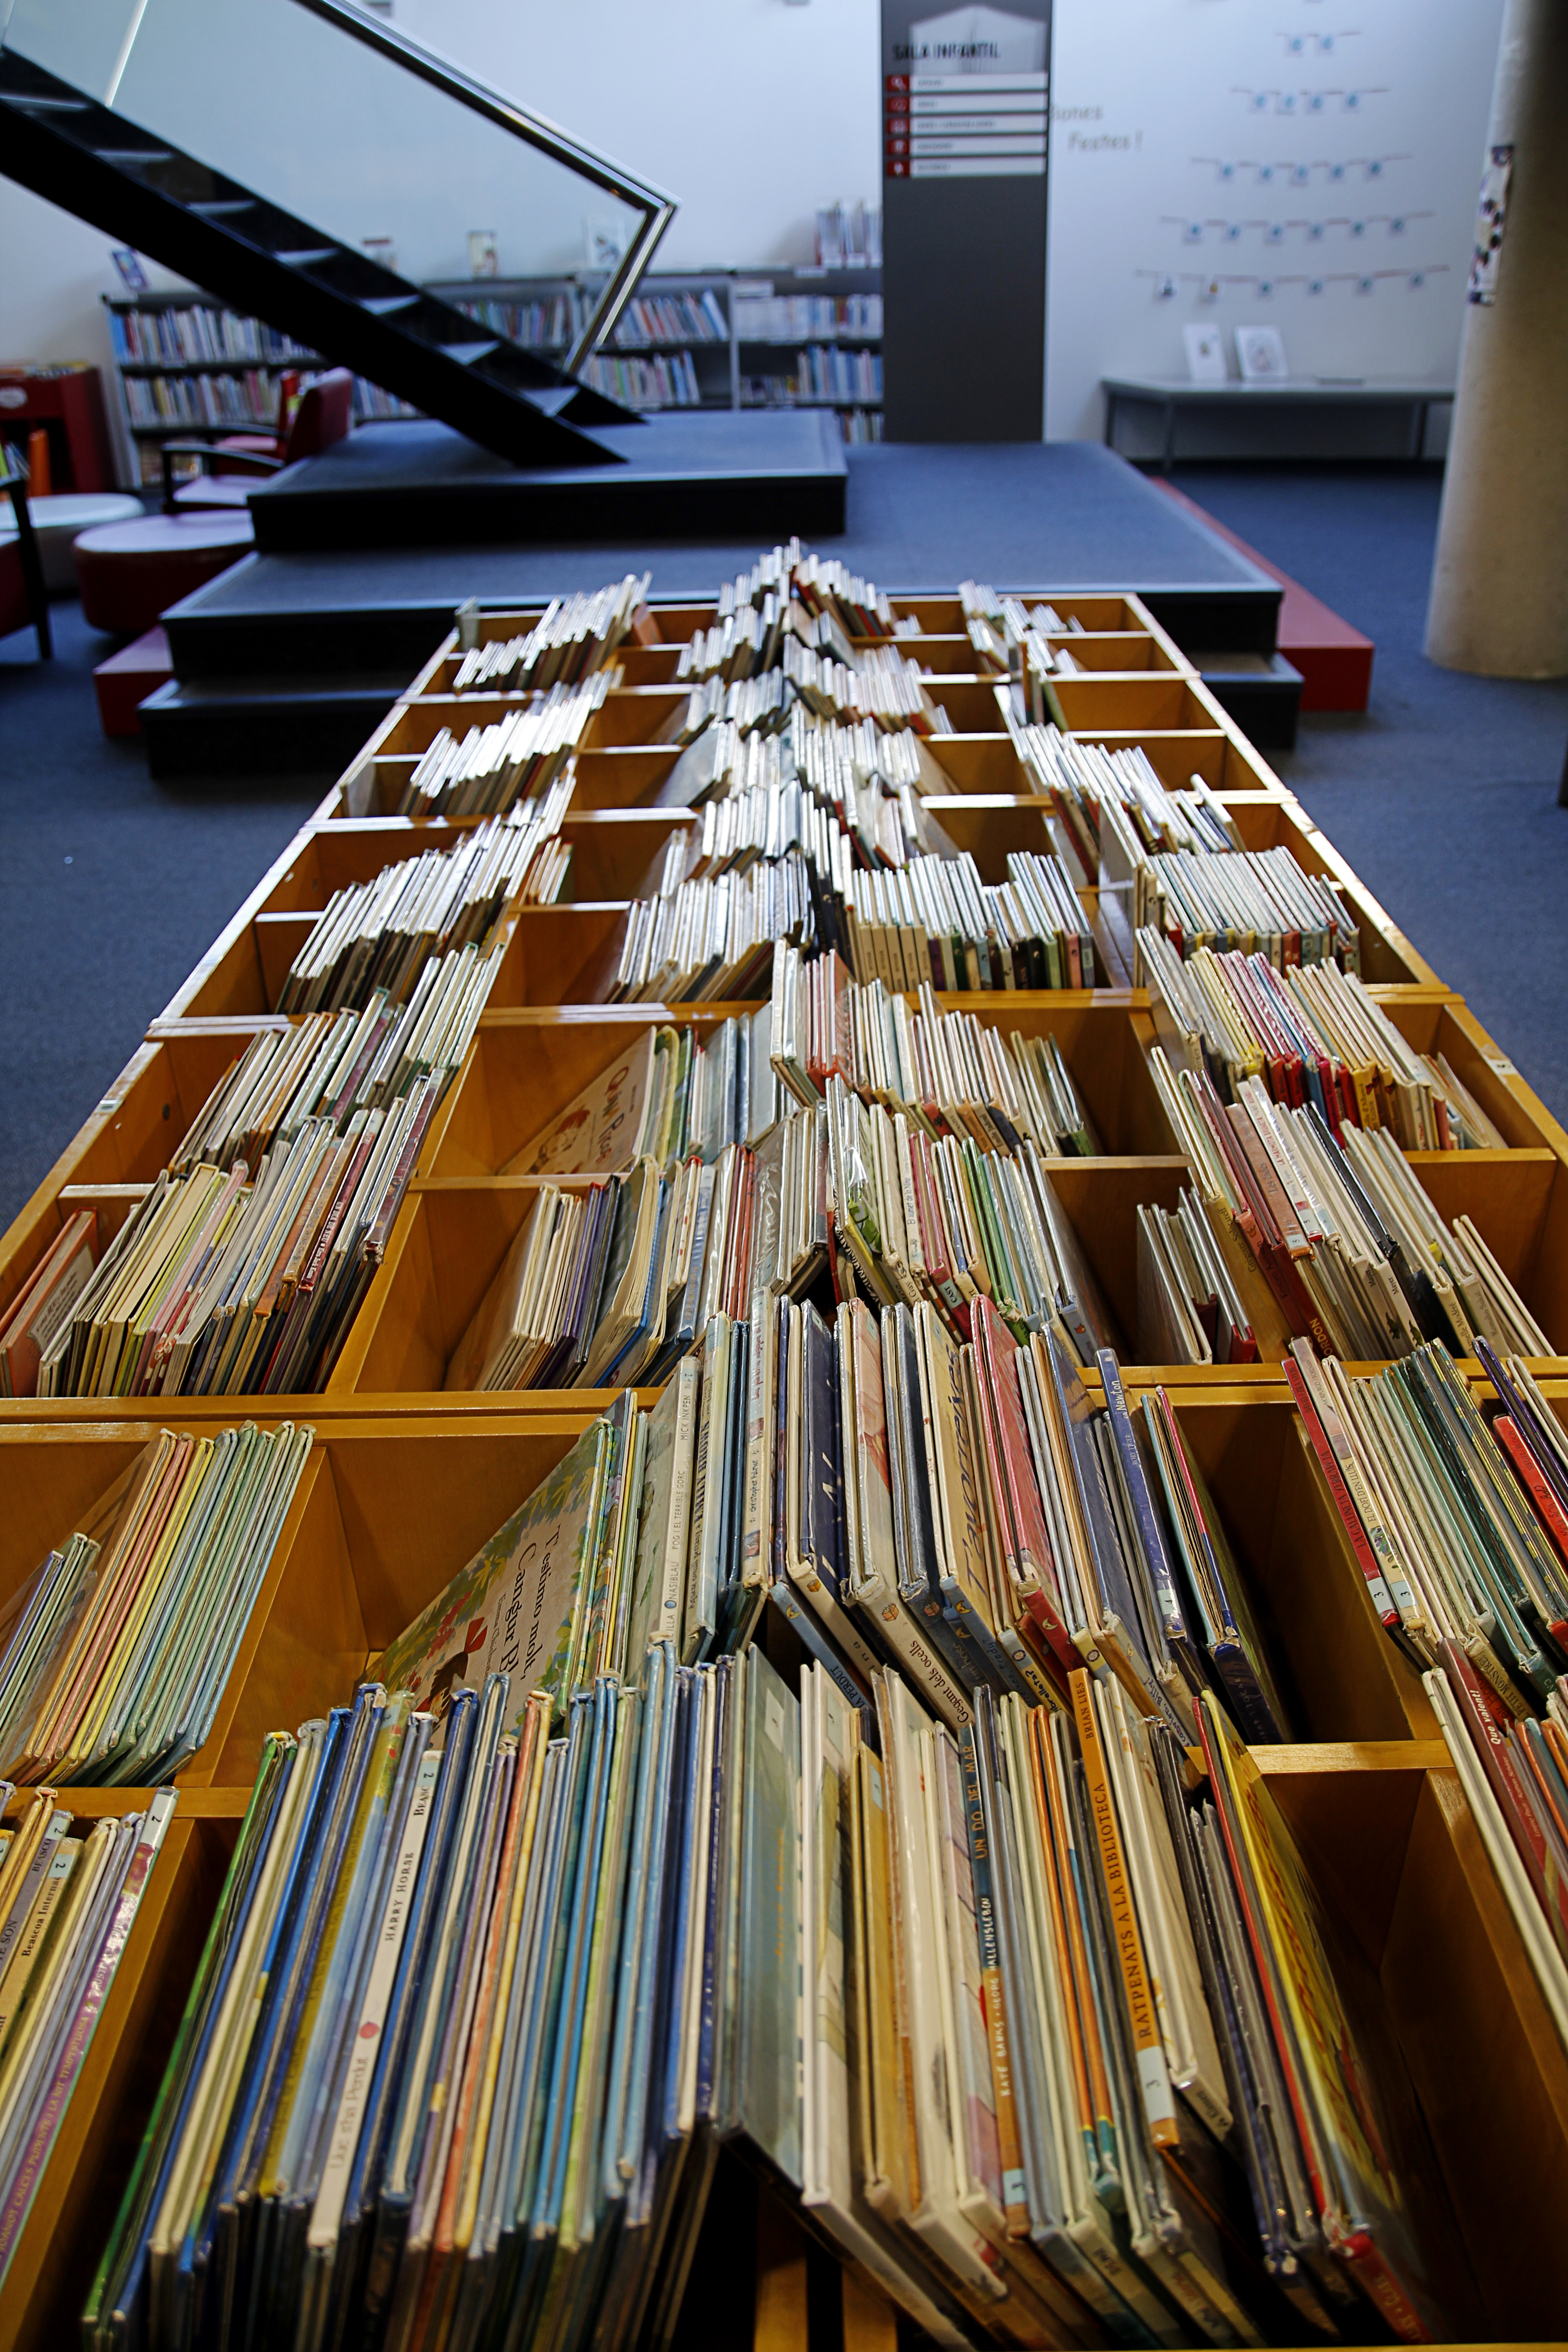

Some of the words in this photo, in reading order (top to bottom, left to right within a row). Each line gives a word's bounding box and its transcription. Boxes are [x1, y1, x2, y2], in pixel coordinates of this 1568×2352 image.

[1388, 1276, 1399, 1295] Mayer
[681, 1395, 691, 1421] INKPEN
[1108, 1379, 1127, 1412] Newton
[680, 1421, 689, 1441] MICK
[1322, 1450, 1344, 1493] XERRAPETA
[1353, 1480, 1366, 1497] D'EN
[675, 1490, 684, 1519] TERRIBLE
[1339, 1494, 1363, 1536] GALLINETA
[1366, 1513, 1376, 1523] EL
[1356, 1535, 1367, 1549] LA
[494, 1592, 506, 1628] Emma
[504, 1542, 537, 1647] Cangur
[520, 1620, 543, 1681] molt,
[905, 1639, 933, 1671] ocells
[828, 1664, 860, 1700] PERDUT
[926, 1666, 947, 1690] dels
[1144, 1677, 1162, 1704] Billy!
[1478, 1655, 1511, 1695] MONSTRE!
[938, 1685, 973, 1725] Gegant
[1078, 1682, 1087, 1705] LIES
[1470, 1689, 1490, 1723] valent!
[1505, 1692, 1525, 1715] PETIT
[1084, 1709, 1094, 1740] BRIAN
[1487, 1723, 1501, 1745] Que
[965, 1744, 976, 1774] MAR
[971, 1813, 985, 1833] DO
[1093, 1782, 1122, 1880] BIBLIOTECA
[976, 1837, 988, 1860] UN
[385, 1899, 404, 1942] HARRY
[396, 1852, 414, 1893] HORSE
[1115, 1885, 1128, 1906] LA
[3, 1919, 18, 1944] SON
[1117, 1910, 1130, 1922] A
[21, 1919, 45, 1957] Beascoa
[980, 1898, 998, 1971] HALLENSLEBEN
[1121, 1928, 1152, 2039] RATPENATS
[995, 2021, 1007, 2058] BANKS
[1000, 2065, 1011, 2097] KATE
